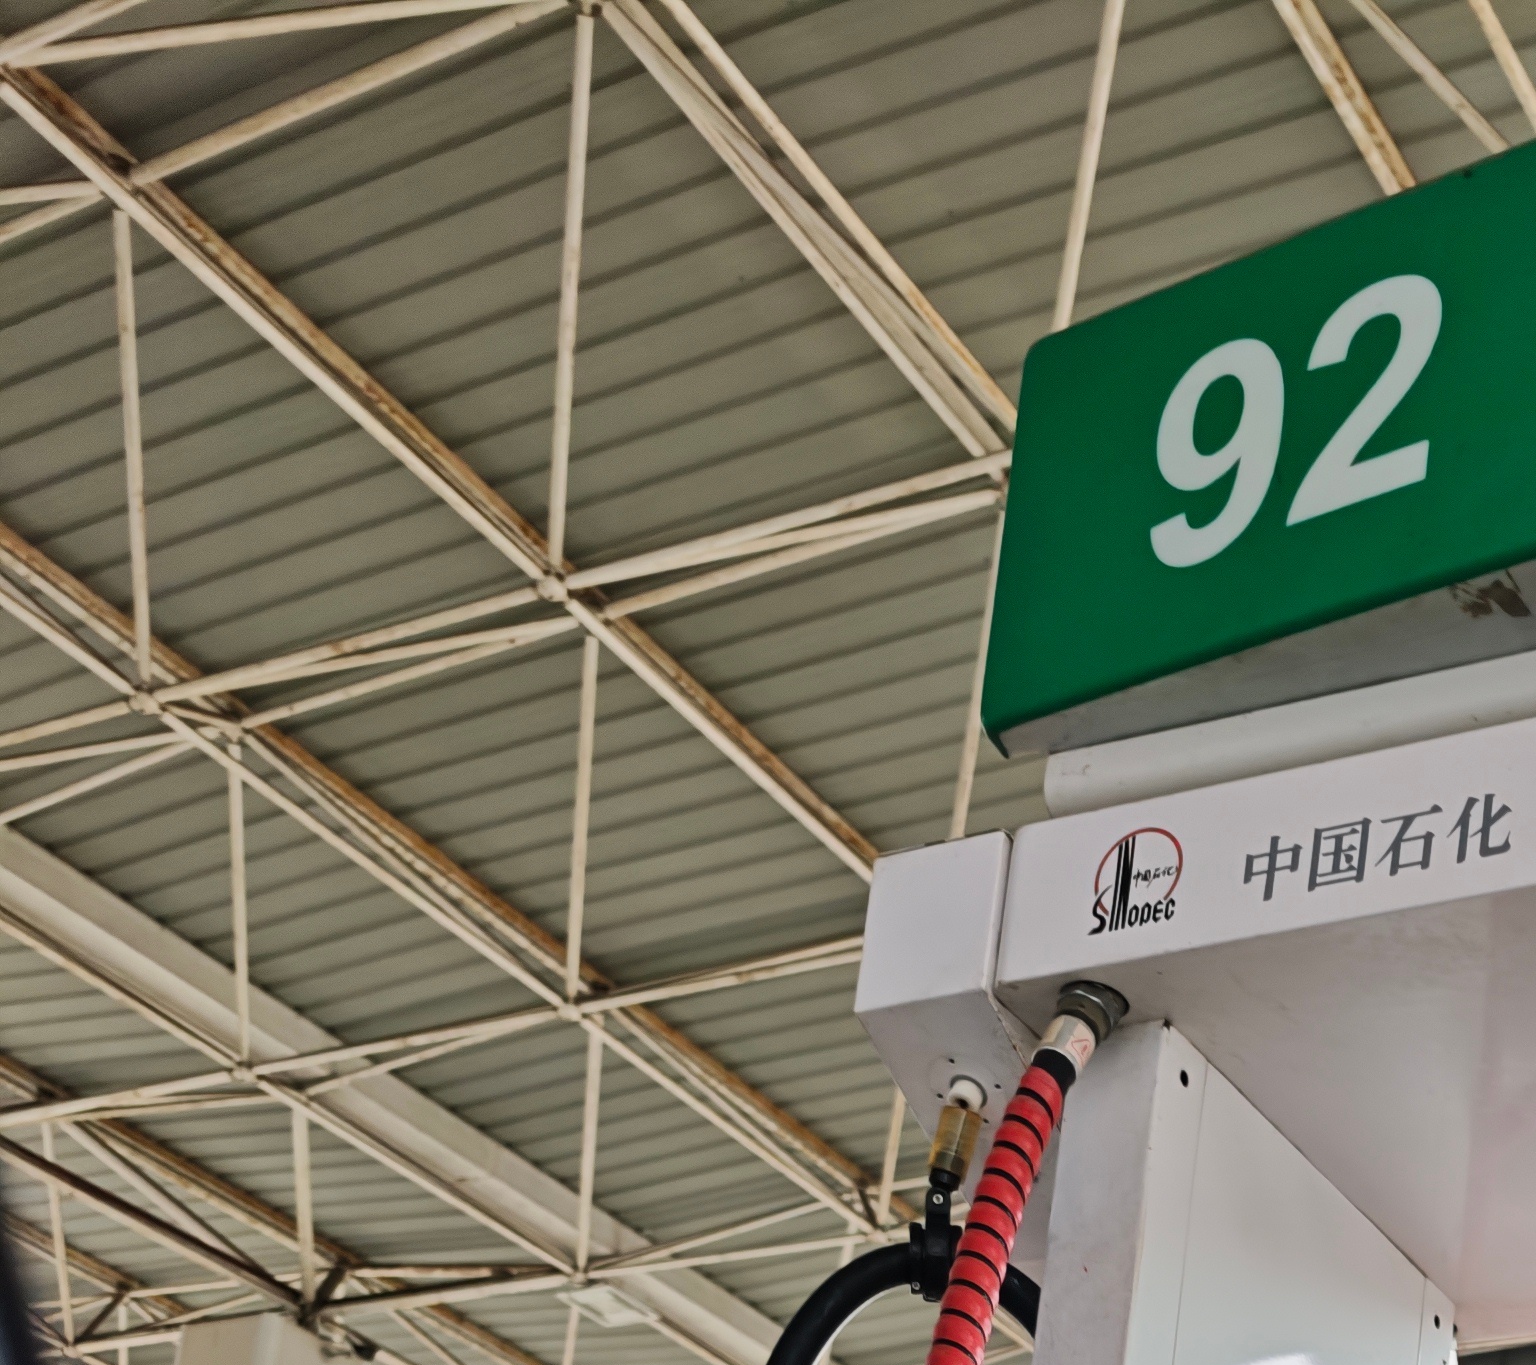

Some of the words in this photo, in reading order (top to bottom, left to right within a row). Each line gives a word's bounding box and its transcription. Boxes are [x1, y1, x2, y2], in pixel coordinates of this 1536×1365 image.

[1149, 273, 1443, 568] 92
[1243, 793, 1513, 902] 中国石化
